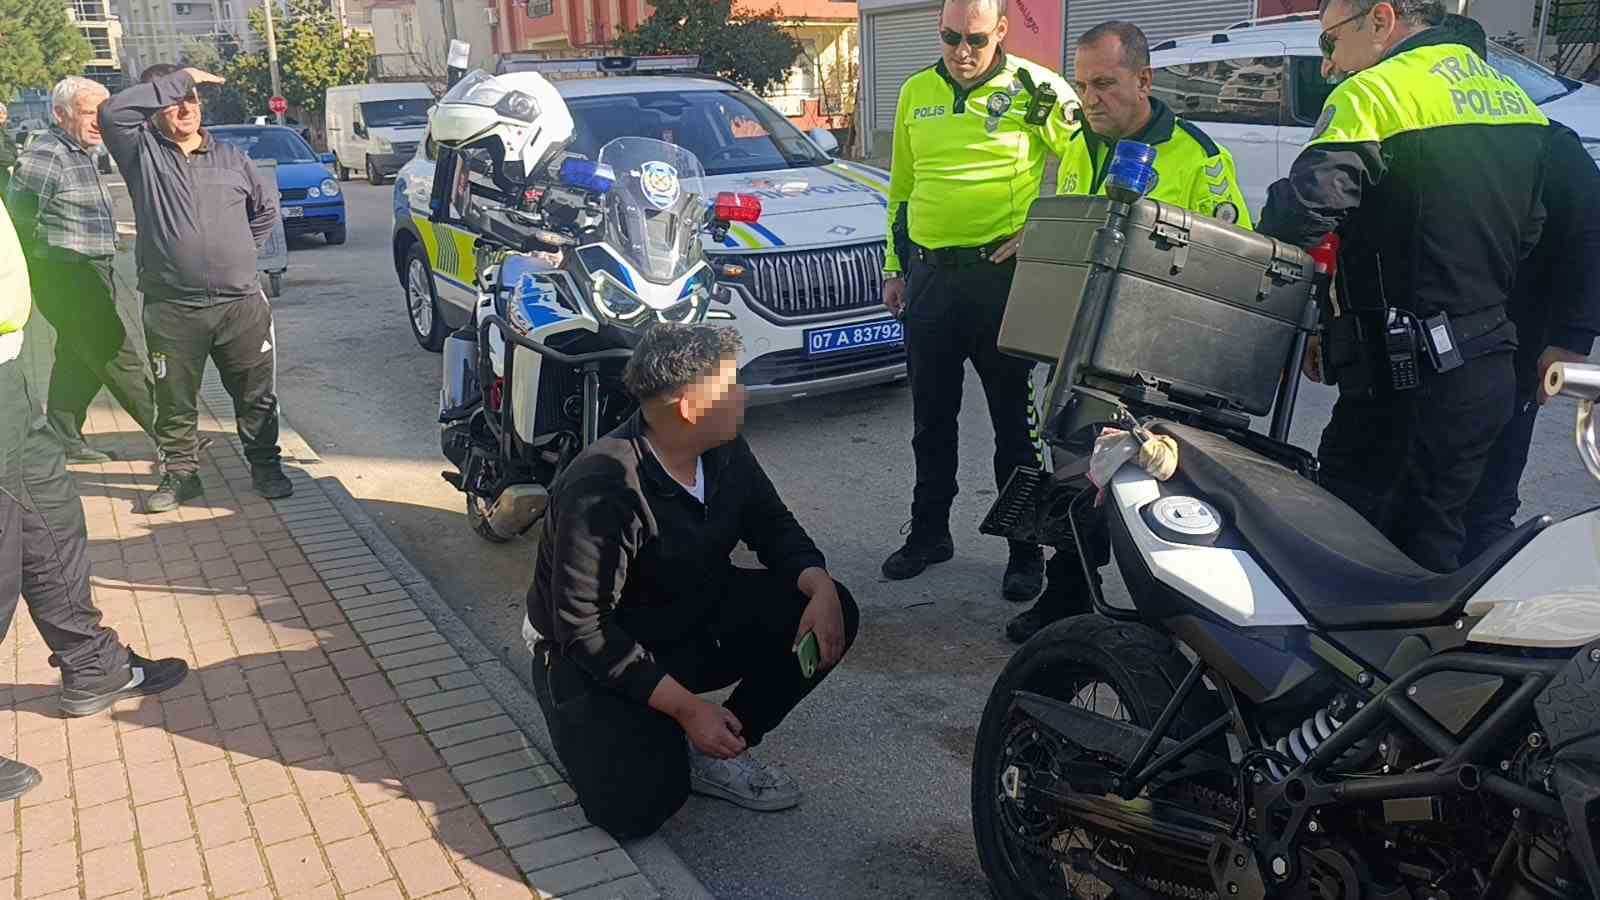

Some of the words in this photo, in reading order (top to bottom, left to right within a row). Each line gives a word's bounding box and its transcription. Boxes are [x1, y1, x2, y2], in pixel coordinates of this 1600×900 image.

[813, 333, 832, 349] 07
[837, 331, 849, 345] A
[854, 323, 900, 343] 83792
